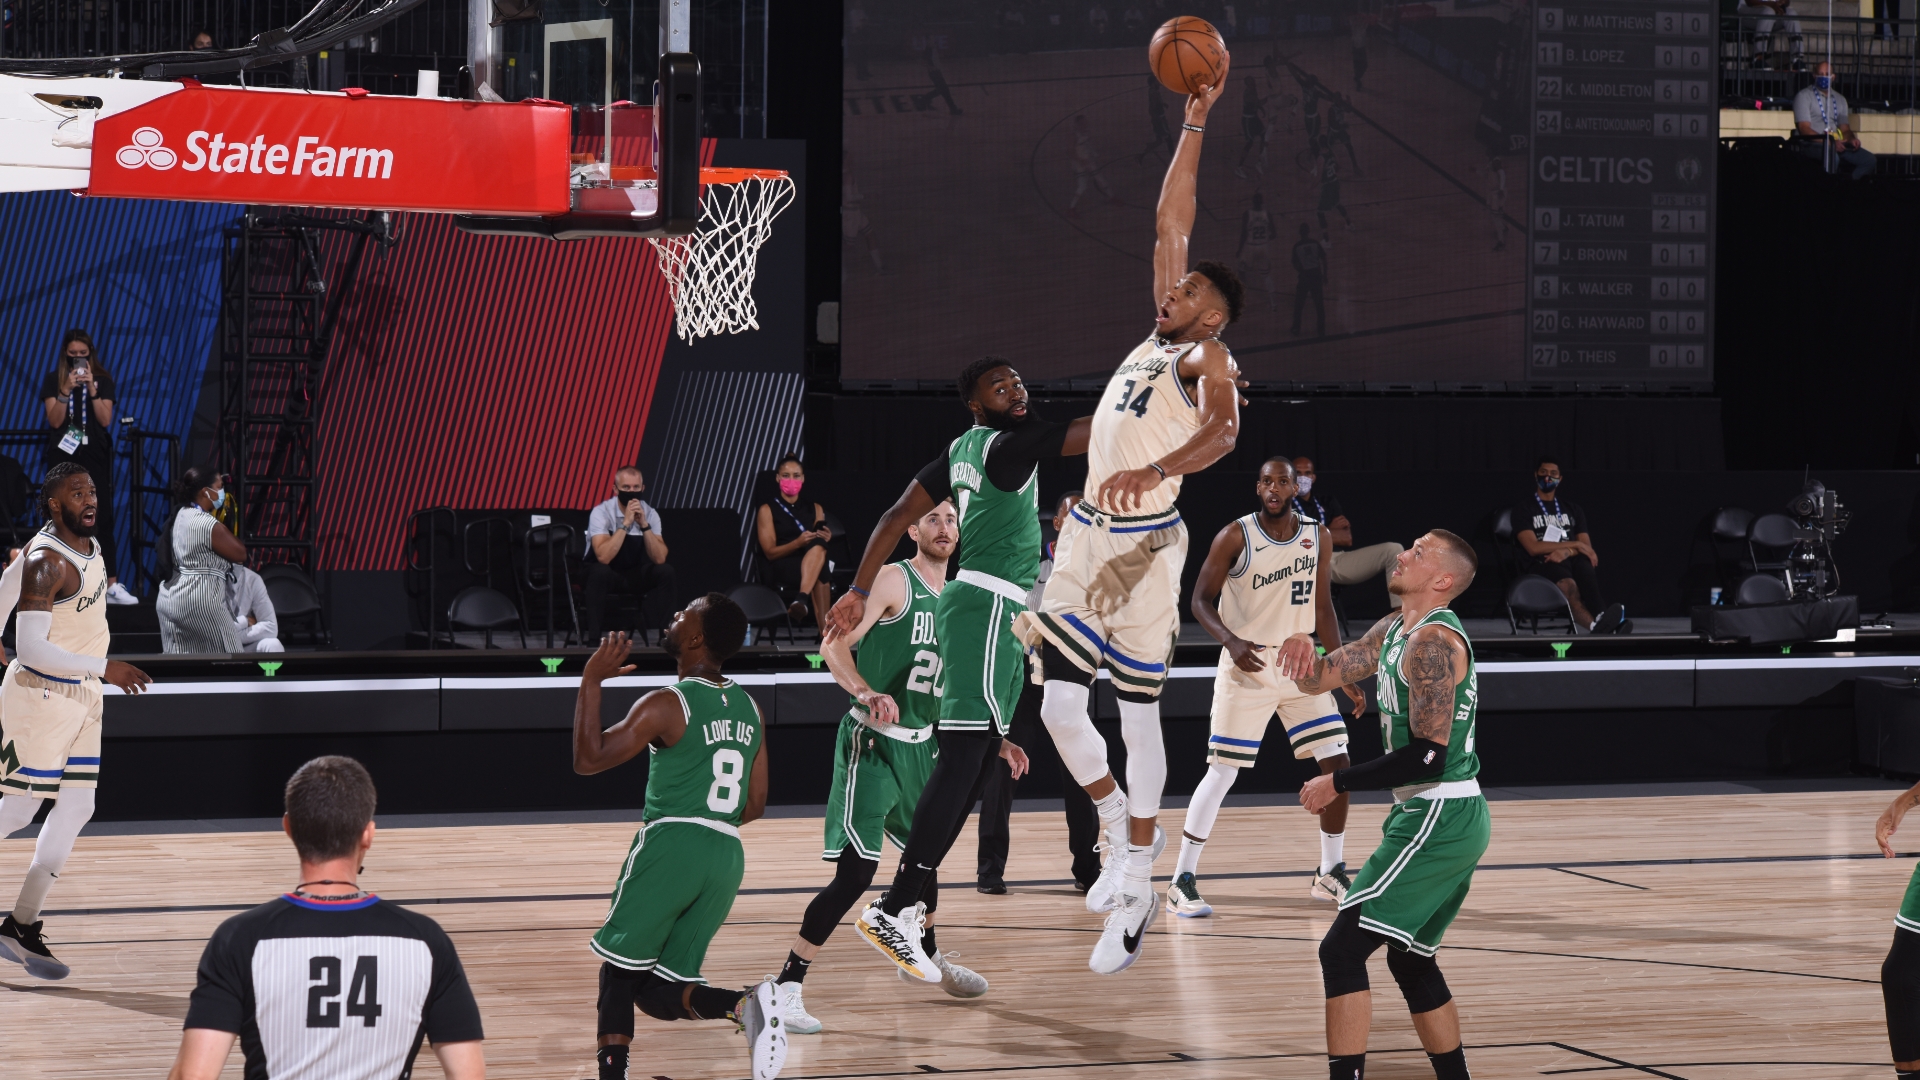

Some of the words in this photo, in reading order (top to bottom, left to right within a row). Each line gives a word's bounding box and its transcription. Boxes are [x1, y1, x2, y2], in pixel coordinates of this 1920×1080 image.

[1545, 12, 1555, 29] 9
[1566, 15, 1580, 27] W.
[1583, 15, 1653, 30] MATTHEWS
[1664, 16, 1673, 31] 3
[1691, 17, 1700, 32] 0
[1540, 46, 1558, 62] 11
[1566, 49, 1578, 61] B.
[1582, 50, 1625, 63] LOPEZ
[1663, 50, 1672, 65] 0
[1691, 51, 1700, 66] 0
[1539, 80, 1559, 97] 22
[1565, 83, 1577, 95] K.
[1580, 83, 1652, 97] MIDDLETON
[1663, 85, 1672, 99] 6
[1690, 85, 1699, 100] 0
[1538, 115, 1558, 131] 34
[1564, 118, 1573, 129] G.
[1662, 119, 1671, 133] 6
[1690, 119, 1699, 134] 0
[1539, 155, 1654, 184] CELTICS
[1542, 211, 1552, 228] 0
[1563, 215, 1574, 227] J.
[1578, 214, 1625, 227] TATUM
[1660, 215, 1670, 229] 2
[1689, 215, 1695, 229] 1
[1541, 246, 1551, 262] 7
[1562, 248, 1574, 261] J.
[1577, 248, 1627, 261] BROWN
[1660, 248, 1669, 263] 0
[1689, 249, 1695, 263] 1
[1541, 280, 1550, 296] 8
[1562, 282, 1574, 295] K.
[1578, 282, 1633, 295] WALKER
[1660, 282, 1668, 297] 0
[1687, 282, 1696, 297] 0
[1535, 314, 1555, 331] 20
[1561, 316, 1574, 329] G.
[1578, 316, 1645, 329] HAYWARD
[1659, 316, 1668, 331] 0
[1686, 316, 1695, 331] 0
[1534, 348, 1554, 365] 27
[1560, 350, 1572, 363] D.
[1577, 350, 1616, 363] THEIS
[1659, 350, 1667, 364] 0
[1686, 350, 1695, 365] 0
[1136, 357, 1169, 380] City
[1114, 379, 1154, 418] 34
[1252, 566, 1292, 590] Cream
[1294, 555, 1316, 575] City
[906, 649, 945, 698] 20
[703, 719, 734, 746] LOVE
[735, 720, 754, 746] US
[706, 748, 744, 814] 8
[328, 893, 359, 902] COMBAT
[306, 955, 382, 1028] 24
